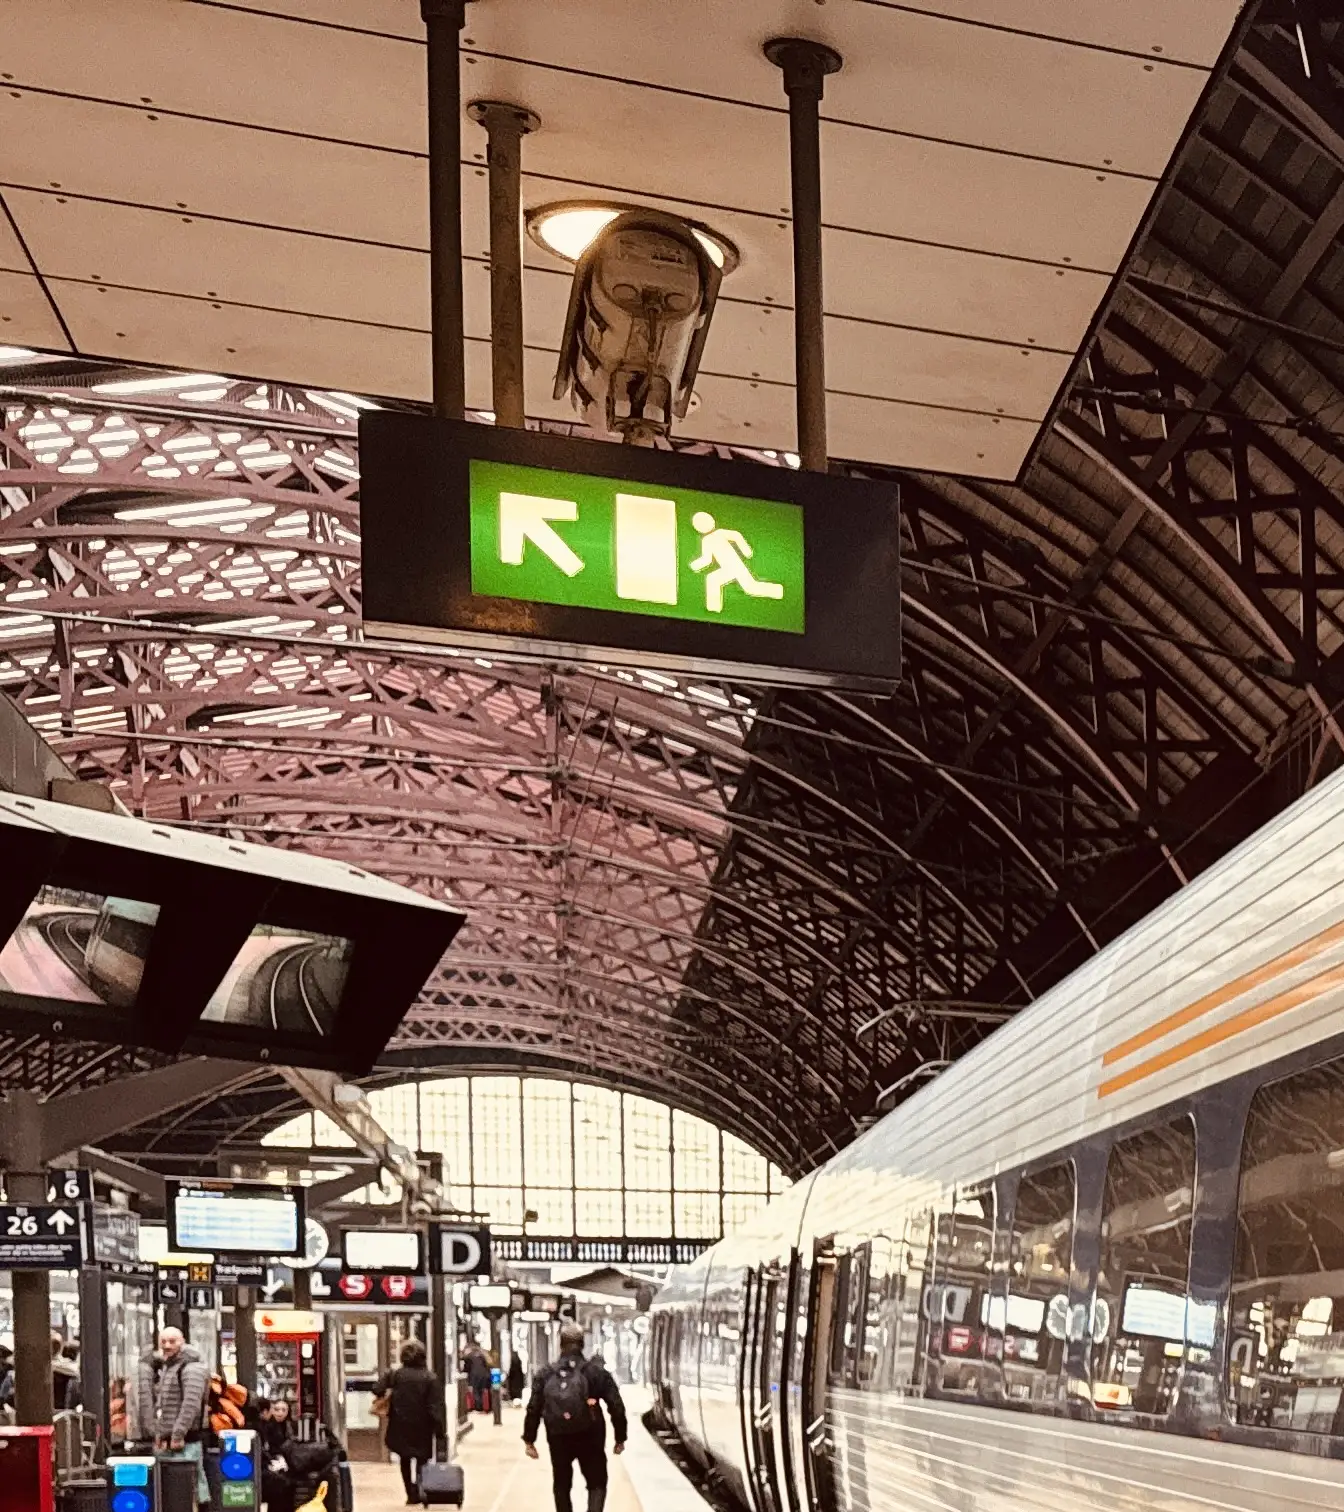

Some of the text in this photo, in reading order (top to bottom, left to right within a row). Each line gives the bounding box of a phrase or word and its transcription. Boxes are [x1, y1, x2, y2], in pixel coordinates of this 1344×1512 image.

[64, 1180, 80, 1199] 6
[7, 1216, 38, 1236] 26
[441, 1231, 482, 1274] D
